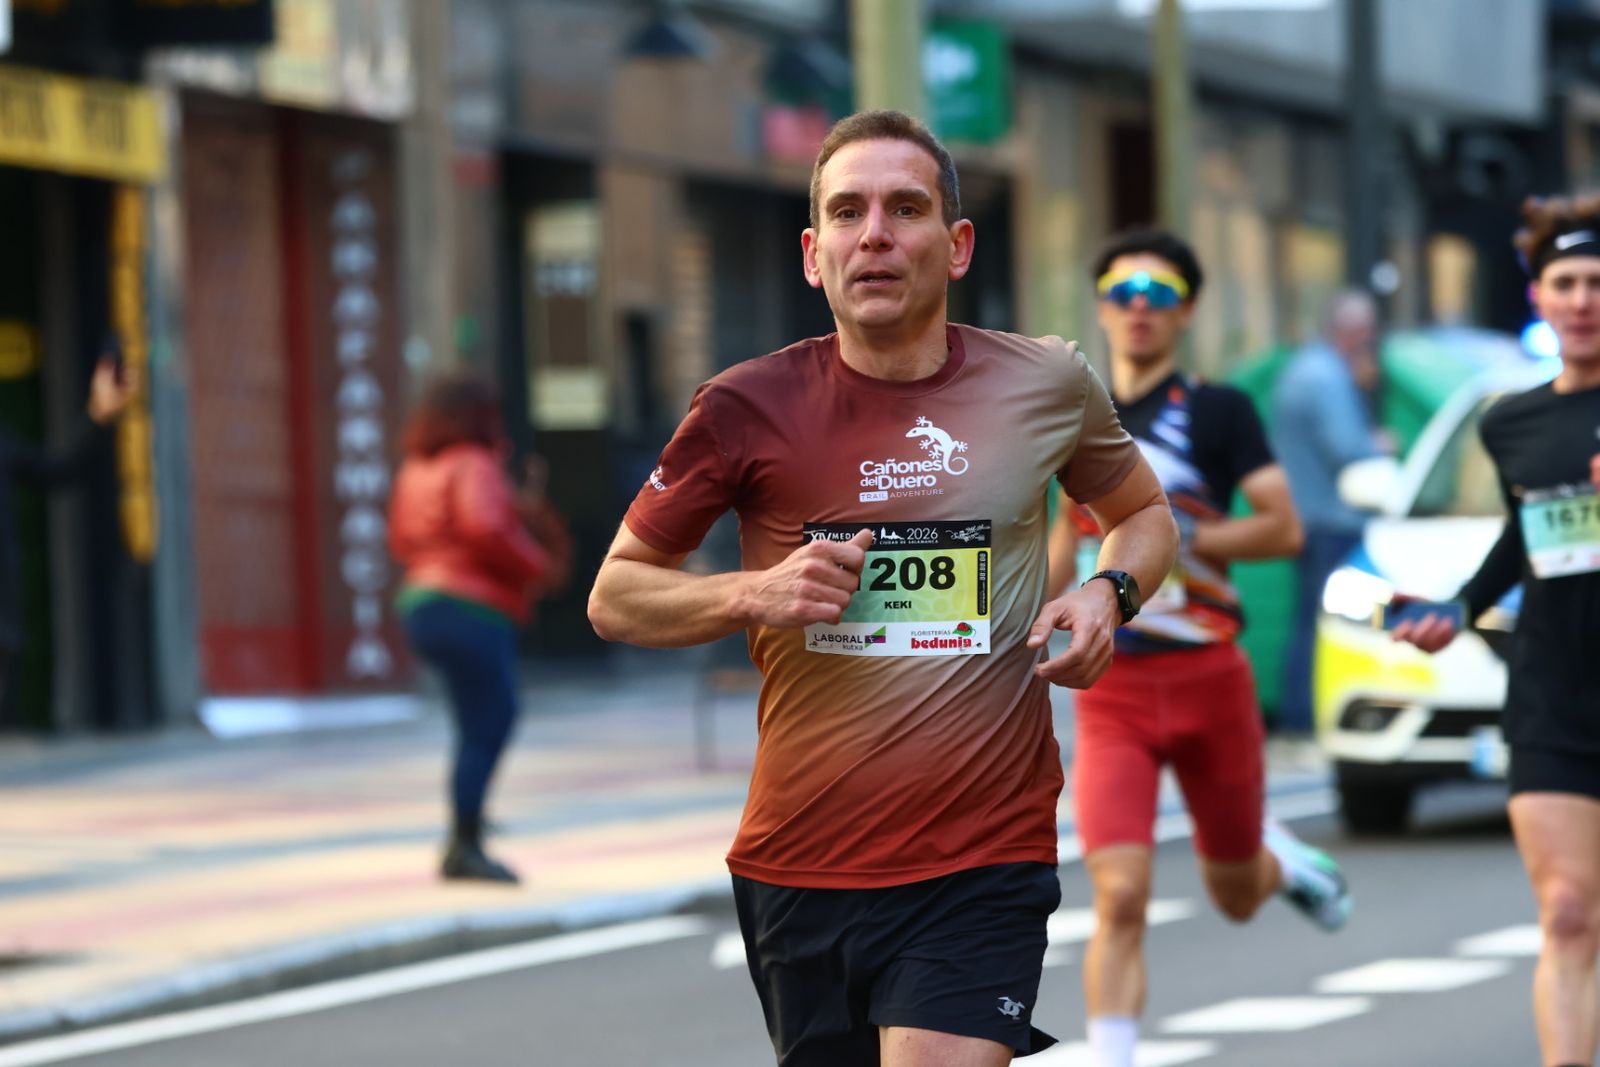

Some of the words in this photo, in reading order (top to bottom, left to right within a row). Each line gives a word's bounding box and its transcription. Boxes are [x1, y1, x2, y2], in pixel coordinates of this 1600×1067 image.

[860, 458, 943, 476] Cañones
[860, 476, 878, 487] del
[878, 474, 937, 490] Duero
[861, 493, 887, 501] TRAIL
[889, 488, 945, 499] ADVENTURE
[832, 532, 856, 540] MEDI
[906, 527, 939, 540] 2026
[884, 600, 912, 610] KEKI
[814, 633, 864, 643] LABORAL
[911, 637, 972, 649] bedunia
